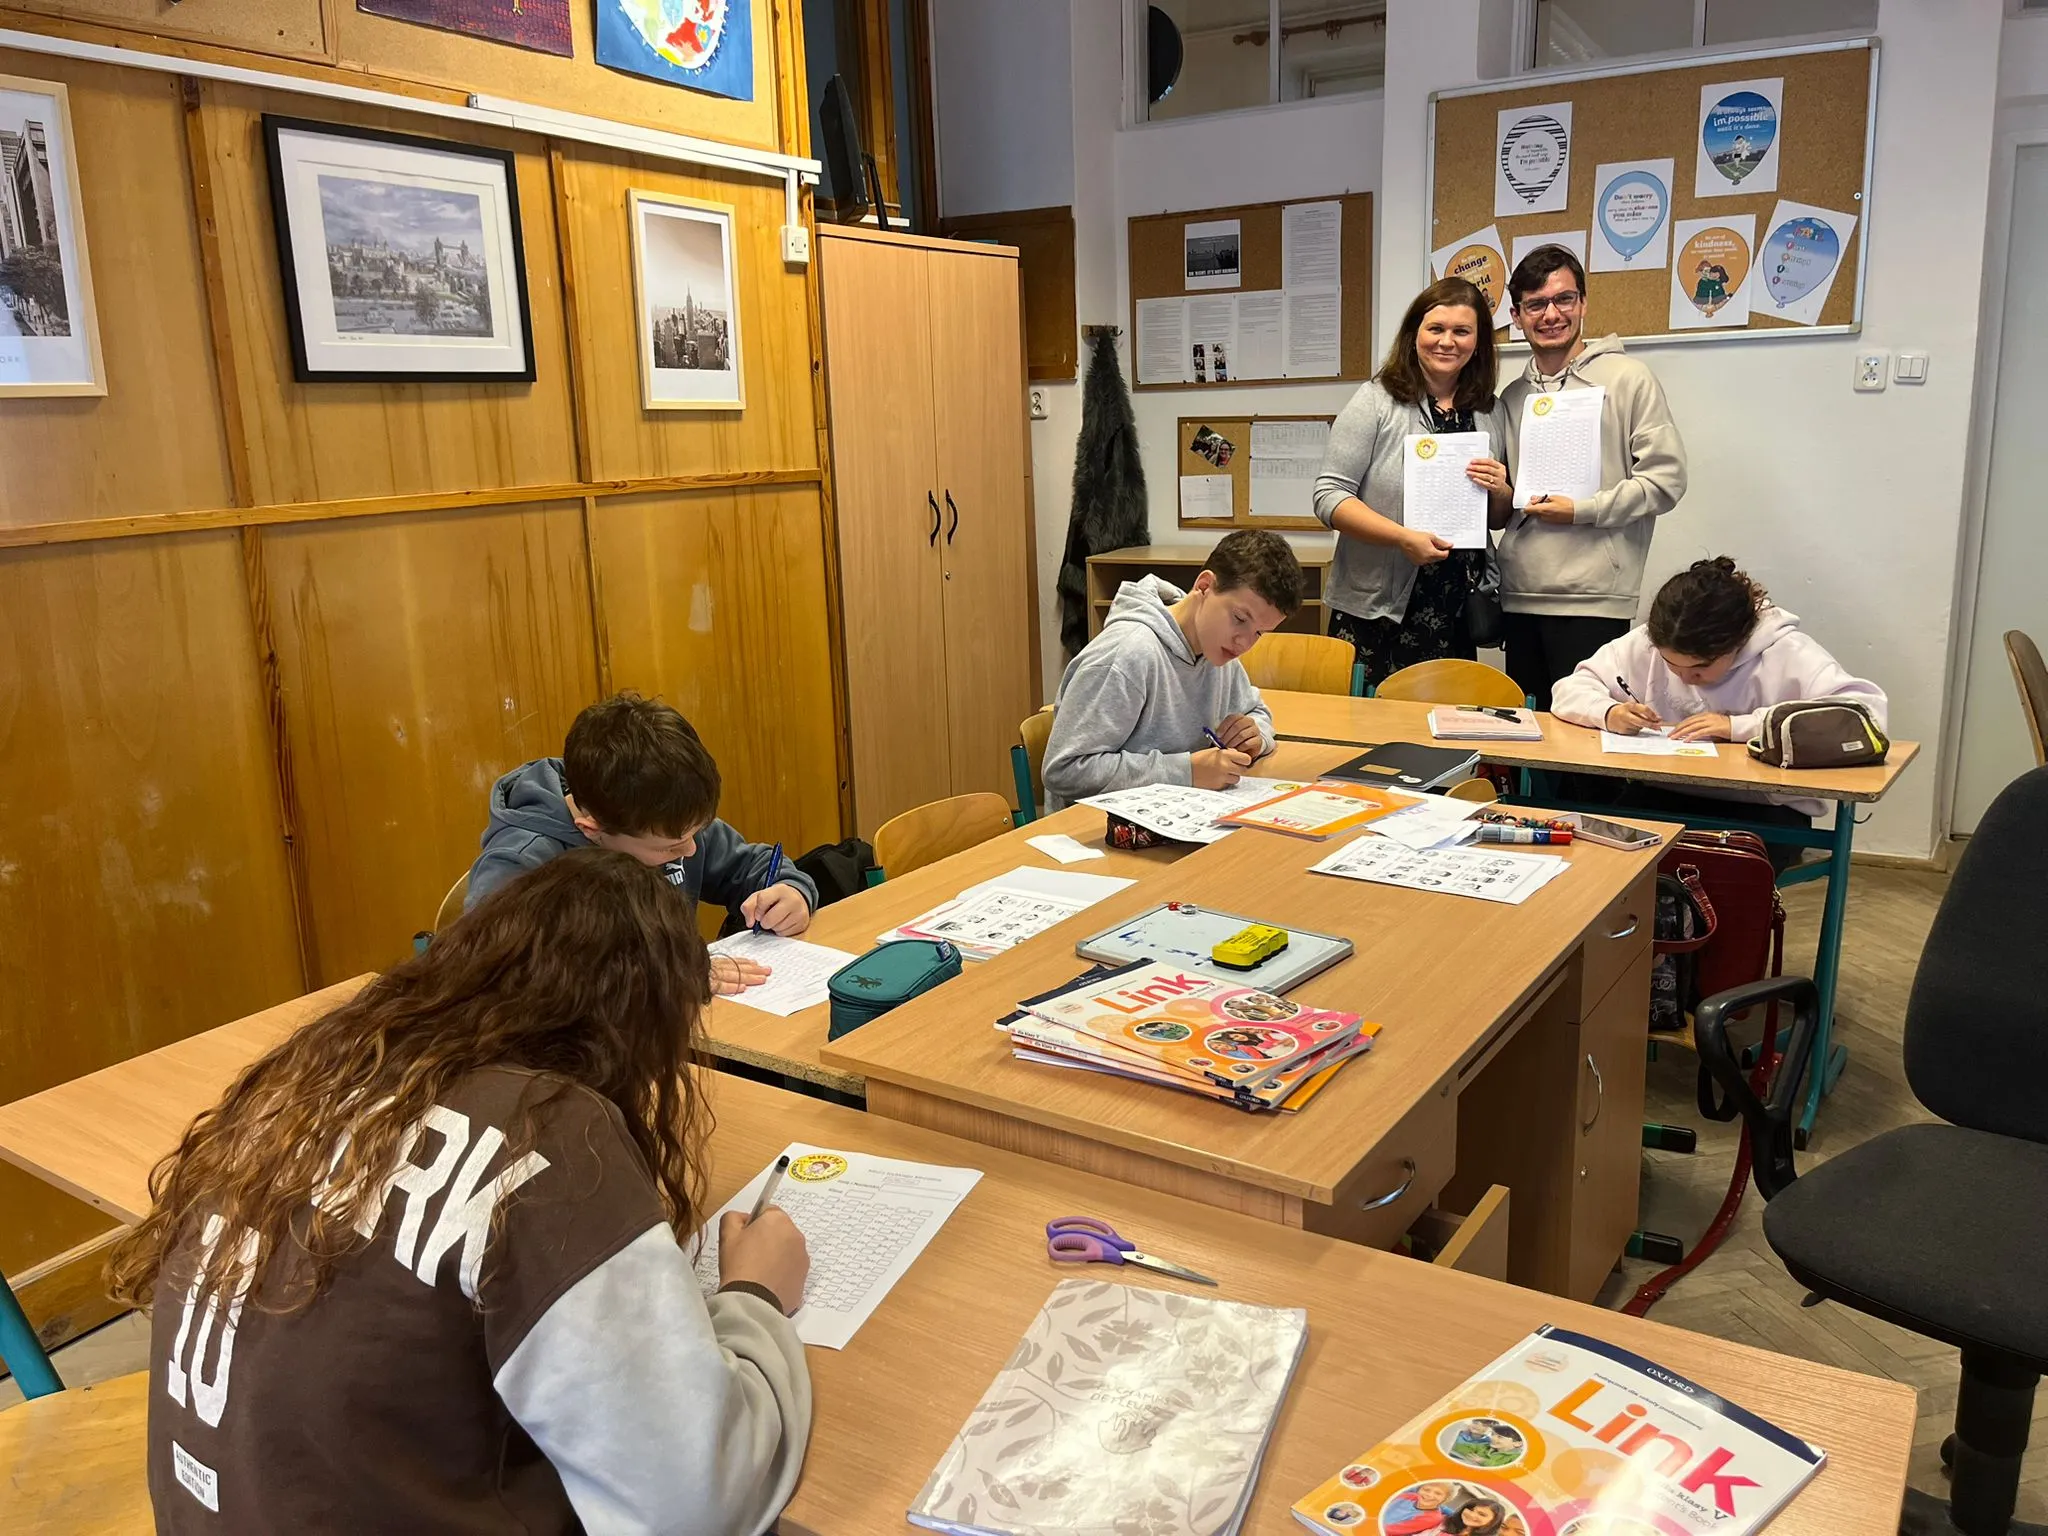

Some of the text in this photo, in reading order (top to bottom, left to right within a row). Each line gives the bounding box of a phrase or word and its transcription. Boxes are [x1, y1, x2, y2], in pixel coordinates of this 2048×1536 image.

[1454, 256, 1488, 274] change
[1092, 974, 1211, 1014] Link
[168, 1214, 260, 1428] 10
[1646, 1367, 1694, 1394] OXFORD
[1546, 1378, 1763, 1517] Link
[1676, 1492, 1708, 1512] klasy
[1714, 1509, 1728, 1521] V
